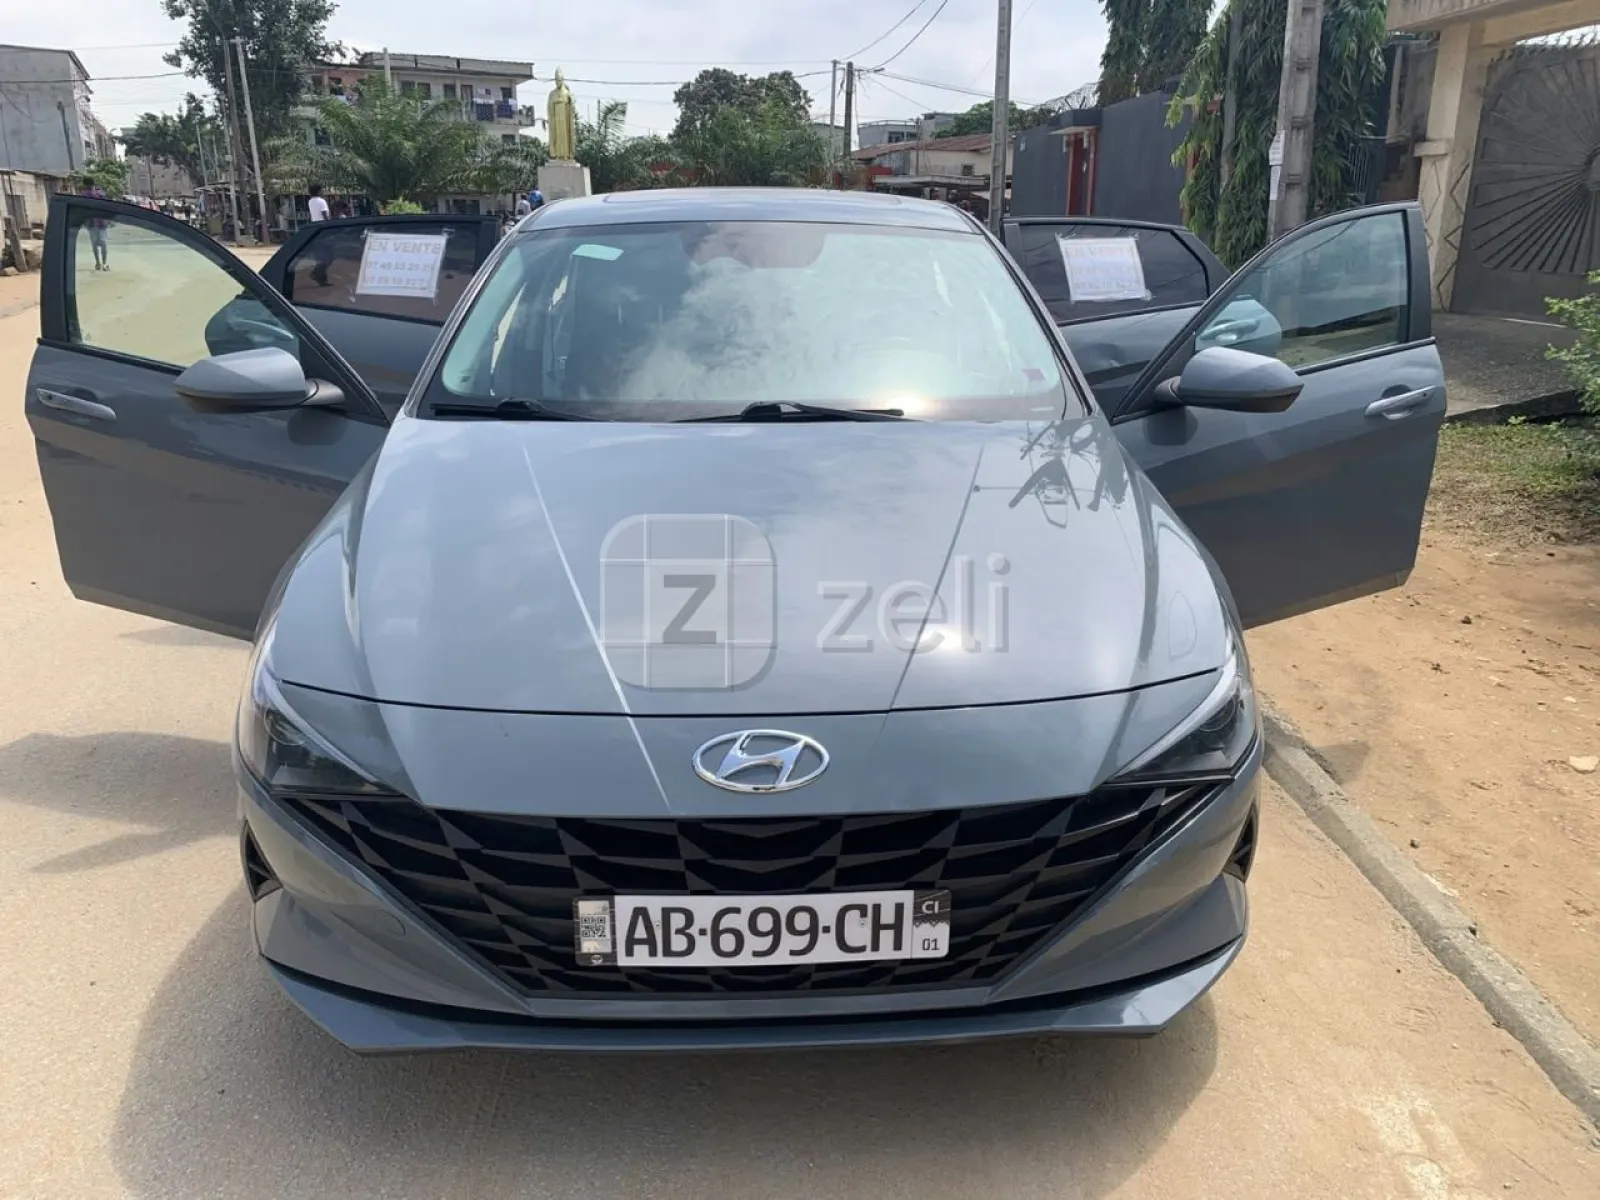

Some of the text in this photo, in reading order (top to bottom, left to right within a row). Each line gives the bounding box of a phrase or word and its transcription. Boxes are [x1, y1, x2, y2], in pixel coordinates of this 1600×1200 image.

[368, 240, 441, 254] EN VENTE
[921, 900, 940, 914] CI
[922, 938, 939, 951] 01
